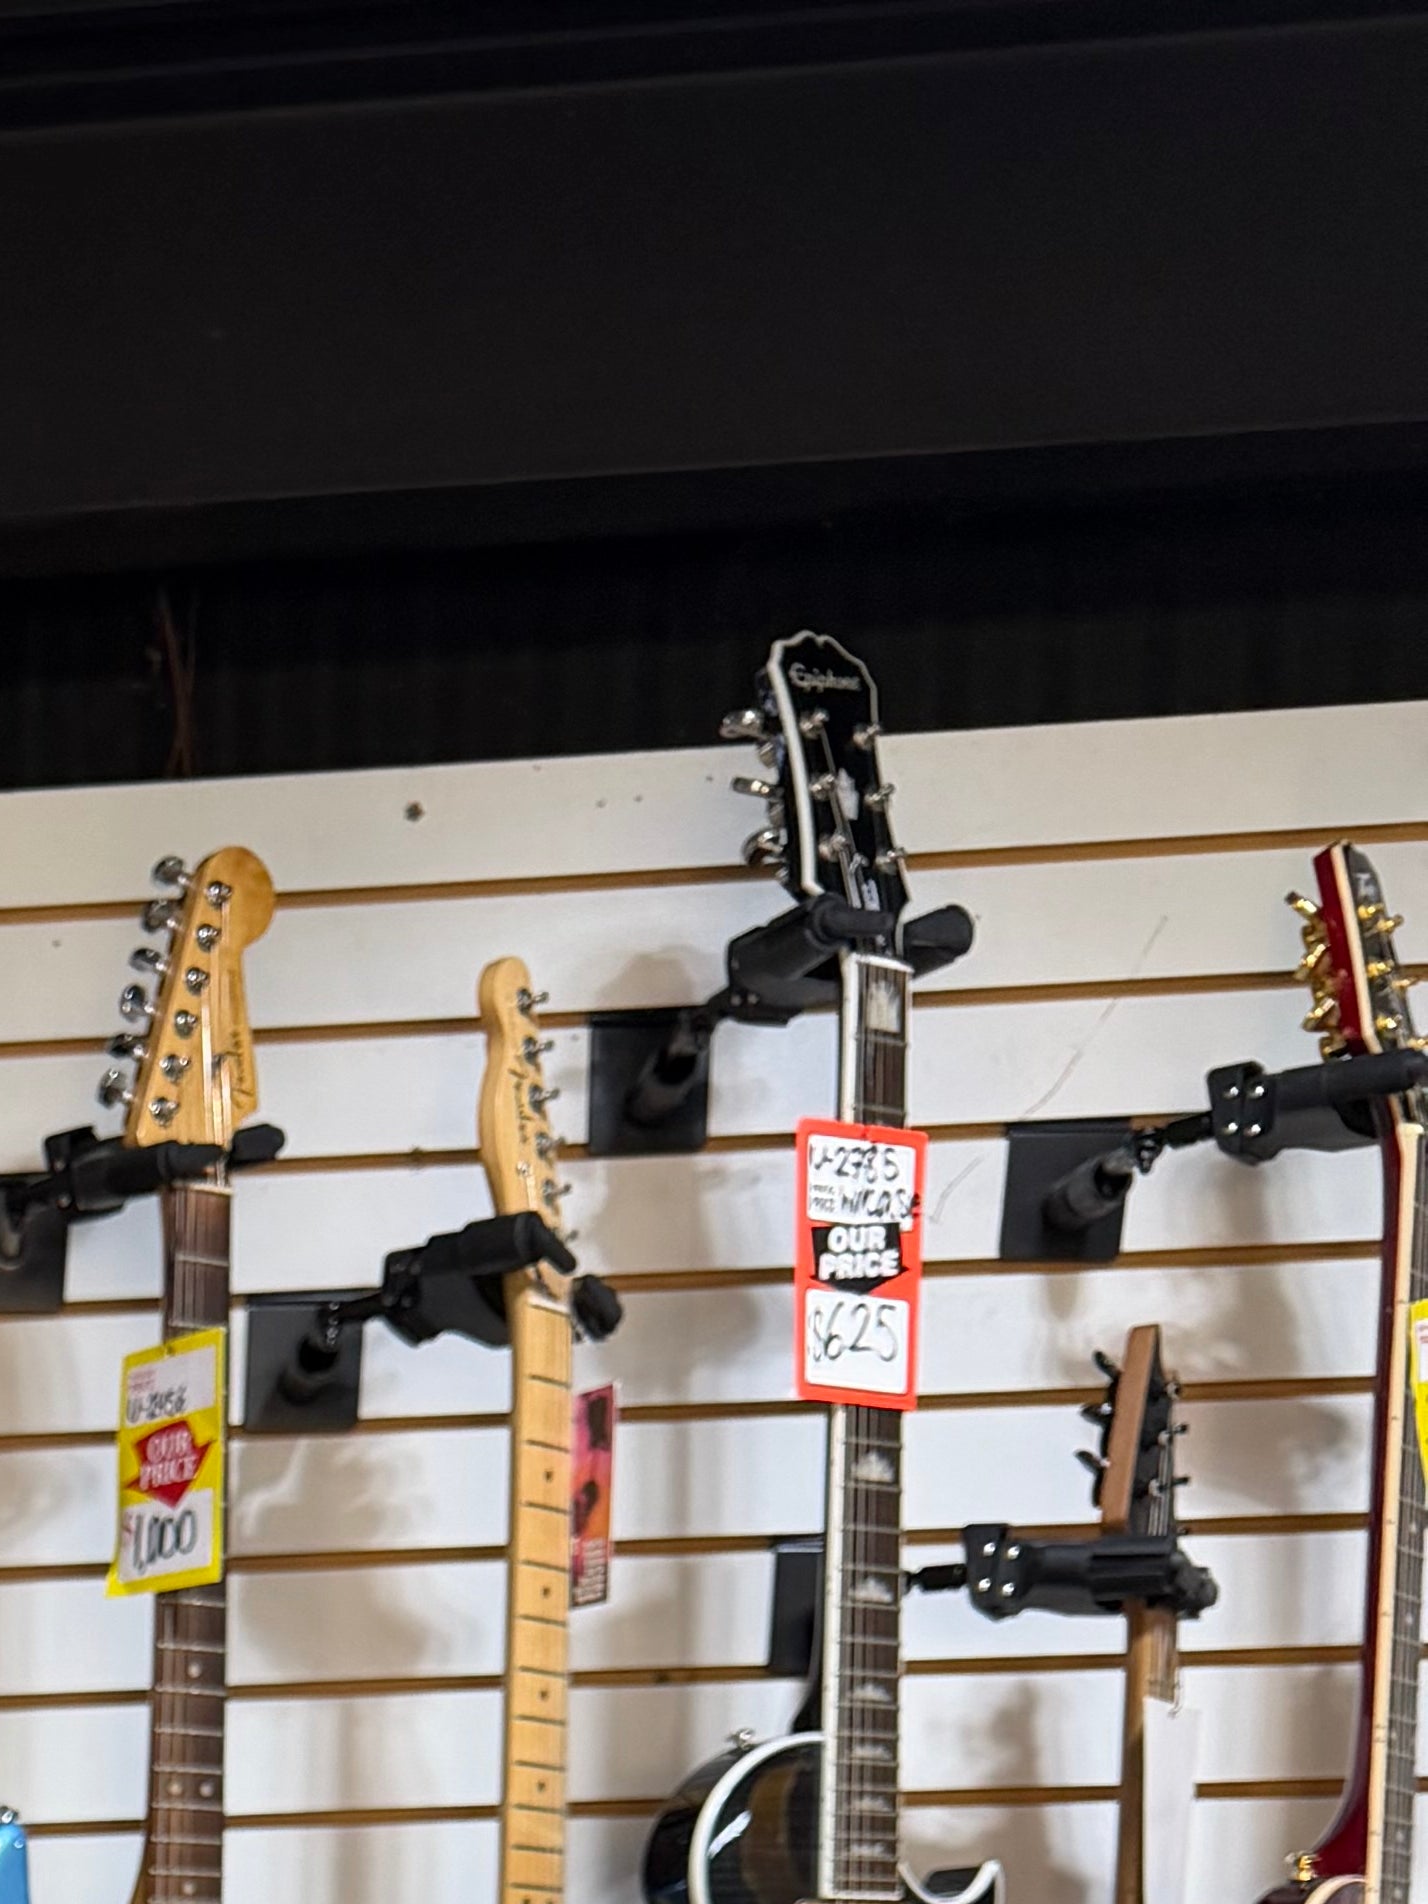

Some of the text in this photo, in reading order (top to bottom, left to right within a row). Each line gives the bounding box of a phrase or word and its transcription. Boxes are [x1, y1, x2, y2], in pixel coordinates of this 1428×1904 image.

[789, 662, 861, 691] Epiphone
[827, 1225, 887, 1252] OUR
[818, 1250, 902, 1282] PRICE
[808, 1301, 898, 1362] $625
[147, 1430, 193, 1463] OUR
[140, 1452, 200, 1490] PRICE
